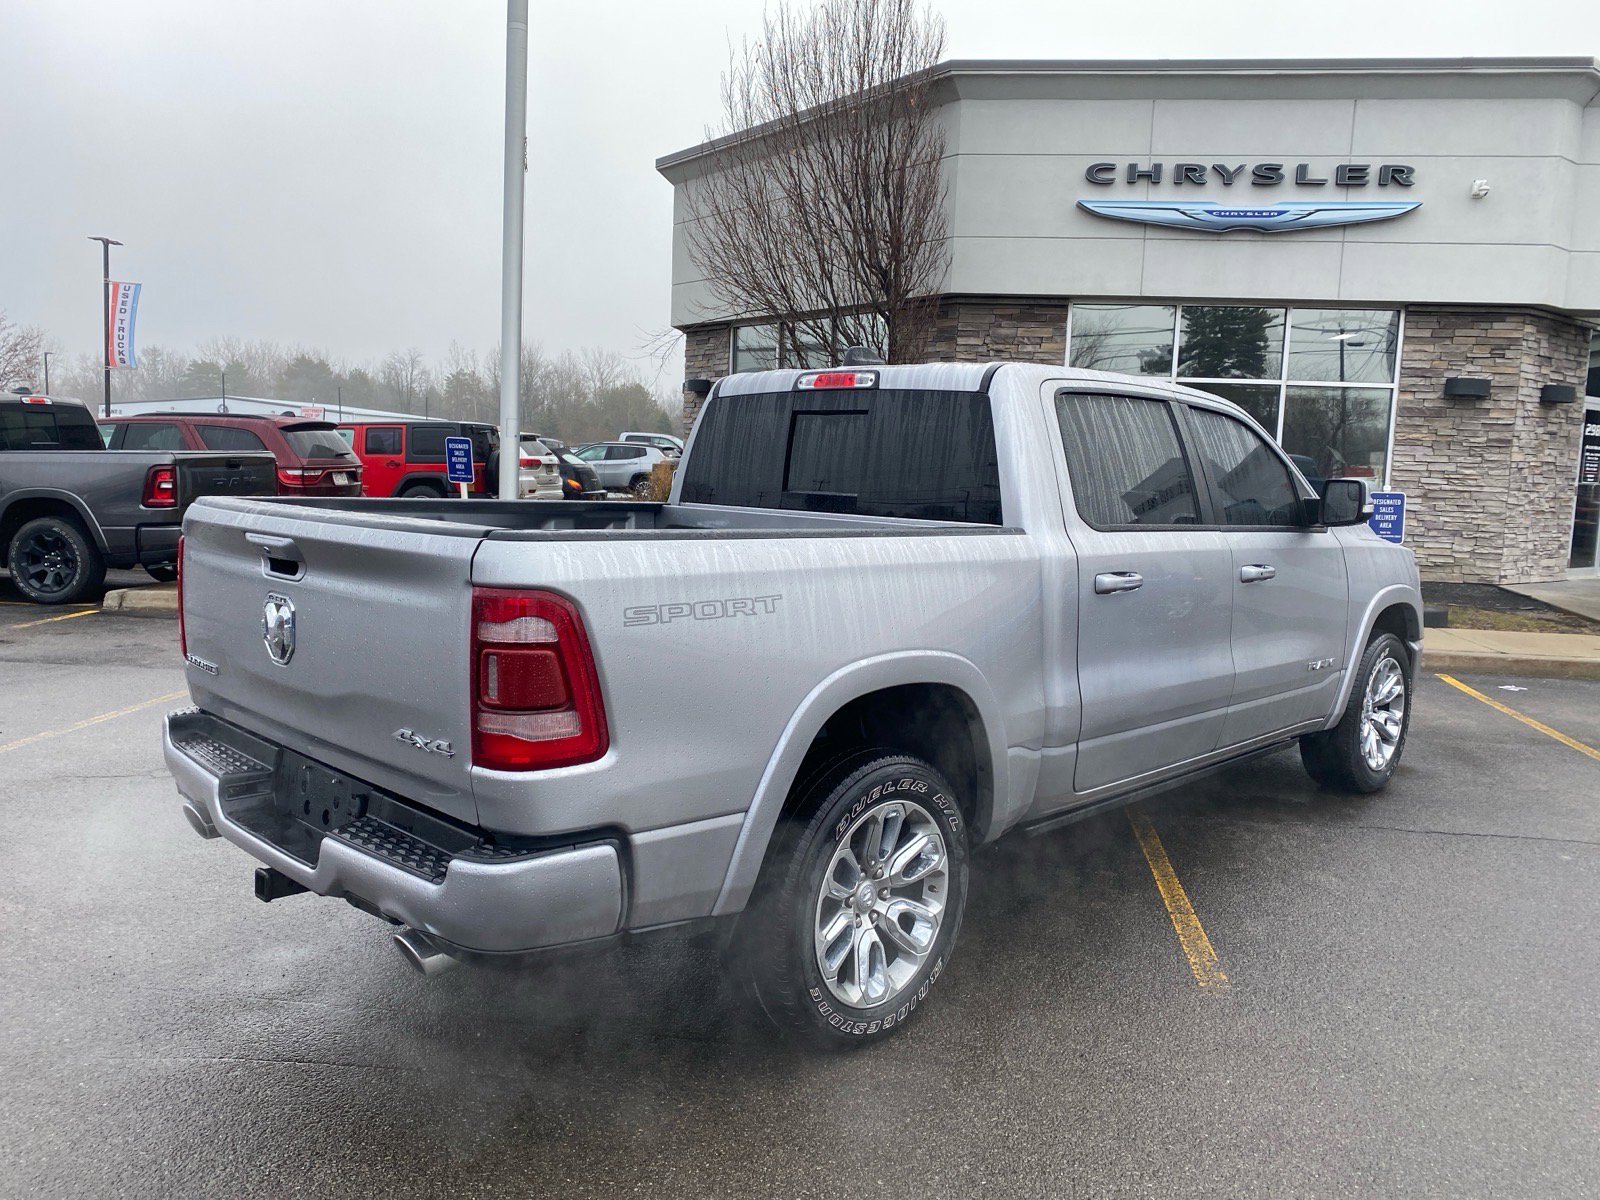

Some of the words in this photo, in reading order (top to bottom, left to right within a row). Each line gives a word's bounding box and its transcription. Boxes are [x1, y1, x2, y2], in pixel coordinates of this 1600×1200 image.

[1085, 162, 1416, 186] CHRYSLER
[119, 285, 131, 314] USED
[117, 318, 126, 364] TRUCKS
[623, 594, 783, 628] SPORT
[1307, 657, 1336, 671] RAM
[836, 778, 928, 841] DUELER
[932, 793, 959, 832] H/L
[809, 956, 943, 1035] BRIDGESTONE
